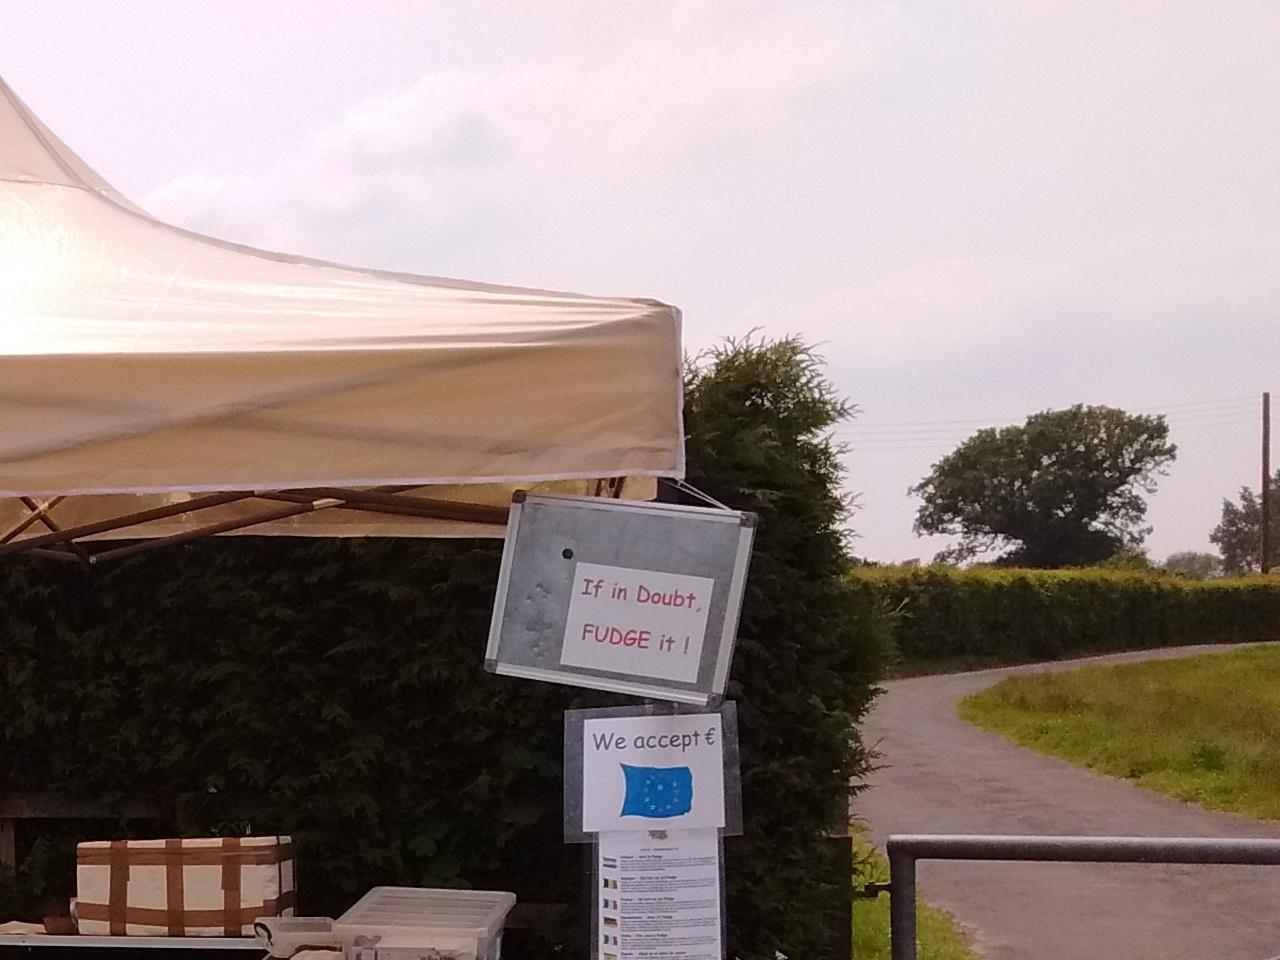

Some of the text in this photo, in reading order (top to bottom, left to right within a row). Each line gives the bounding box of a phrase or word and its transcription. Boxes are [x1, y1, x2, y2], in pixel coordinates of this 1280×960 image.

[581, 578, 702, 613] If in Doubt,
[581, 623, 652, 649] FUDGE
[658, 634, 675, 653] it
[592, 727, 716, 752] We accept €
